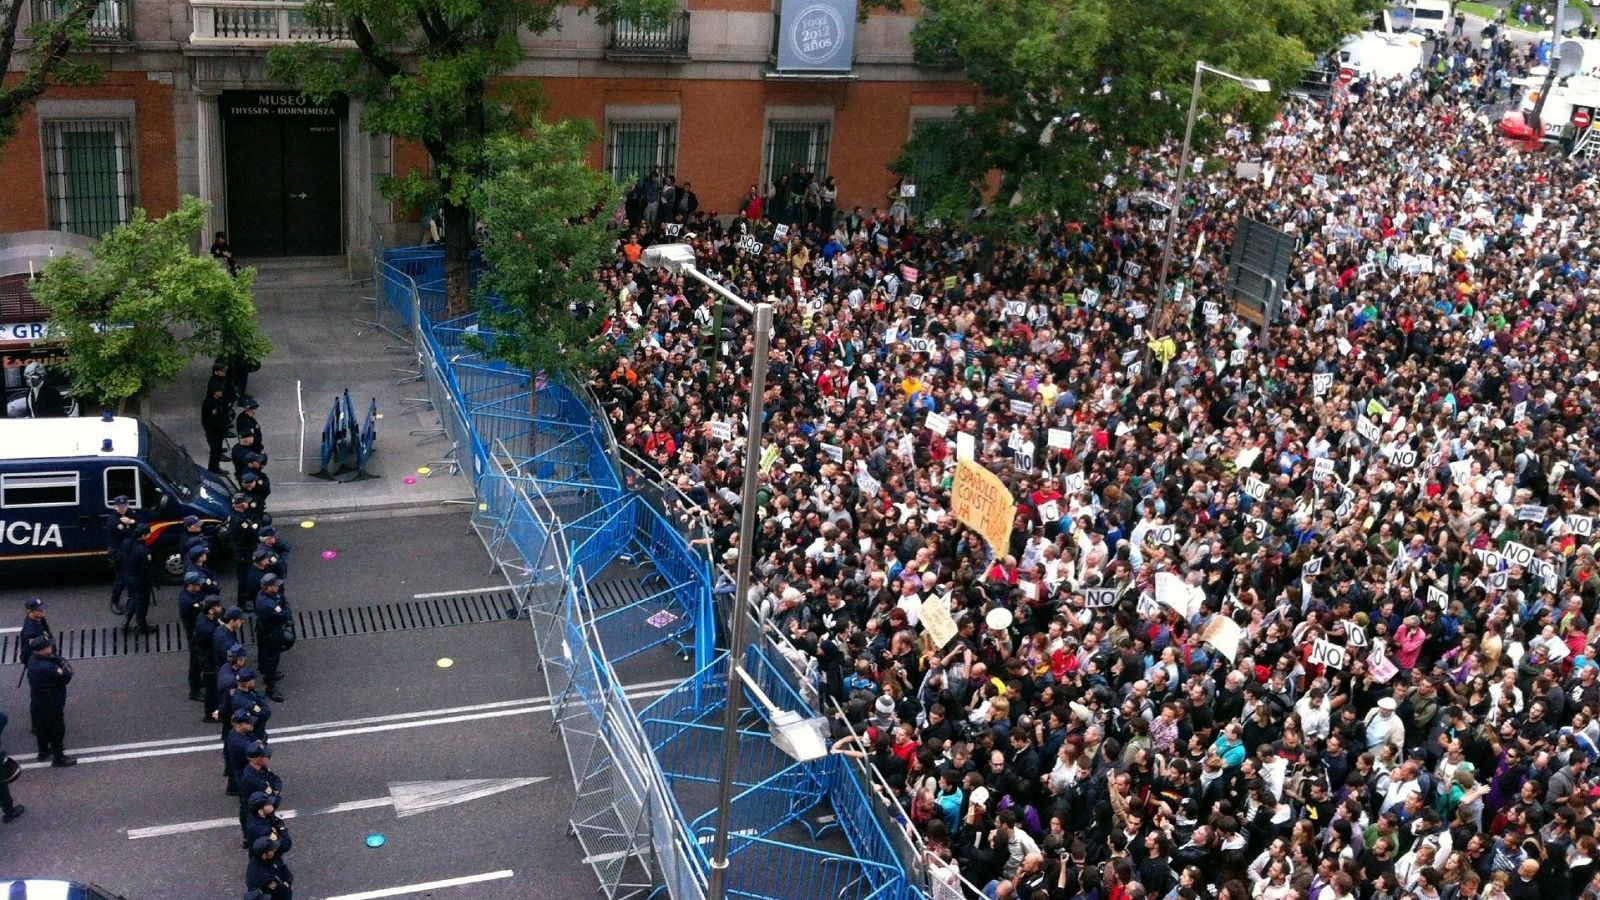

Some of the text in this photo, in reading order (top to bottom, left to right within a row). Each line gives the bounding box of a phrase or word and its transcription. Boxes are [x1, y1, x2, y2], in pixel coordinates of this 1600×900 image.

[801, 26, 831, 41] 2012
[803, 38, 832, 52] años
[259, 95, 306, 106] MUSEO
[231, 107, 269, 115] THYSSEN
[277, 107, 335, 115] BORNEMISZA
[1151, 220, 1164, 230] NO
[1126, 262, 1139, 276] NO
[1008, 303, 1024, 314] NO
[911, 337, 927, 351] NO
[1364, 423, 1378, 441] NO
[1016, 451, 1032, 470] NO
[1391, 452, 1414, 467] NO
[1067, 474, 1082, 492] NO
[1247, 478, 1264, 499] NO
[1568, 517, 1589, 533] NO
[1504, 543, 1531, 563] NO
[1088, 591, 1115, 606] NO
[1314, 642, 1341, 667] NO
